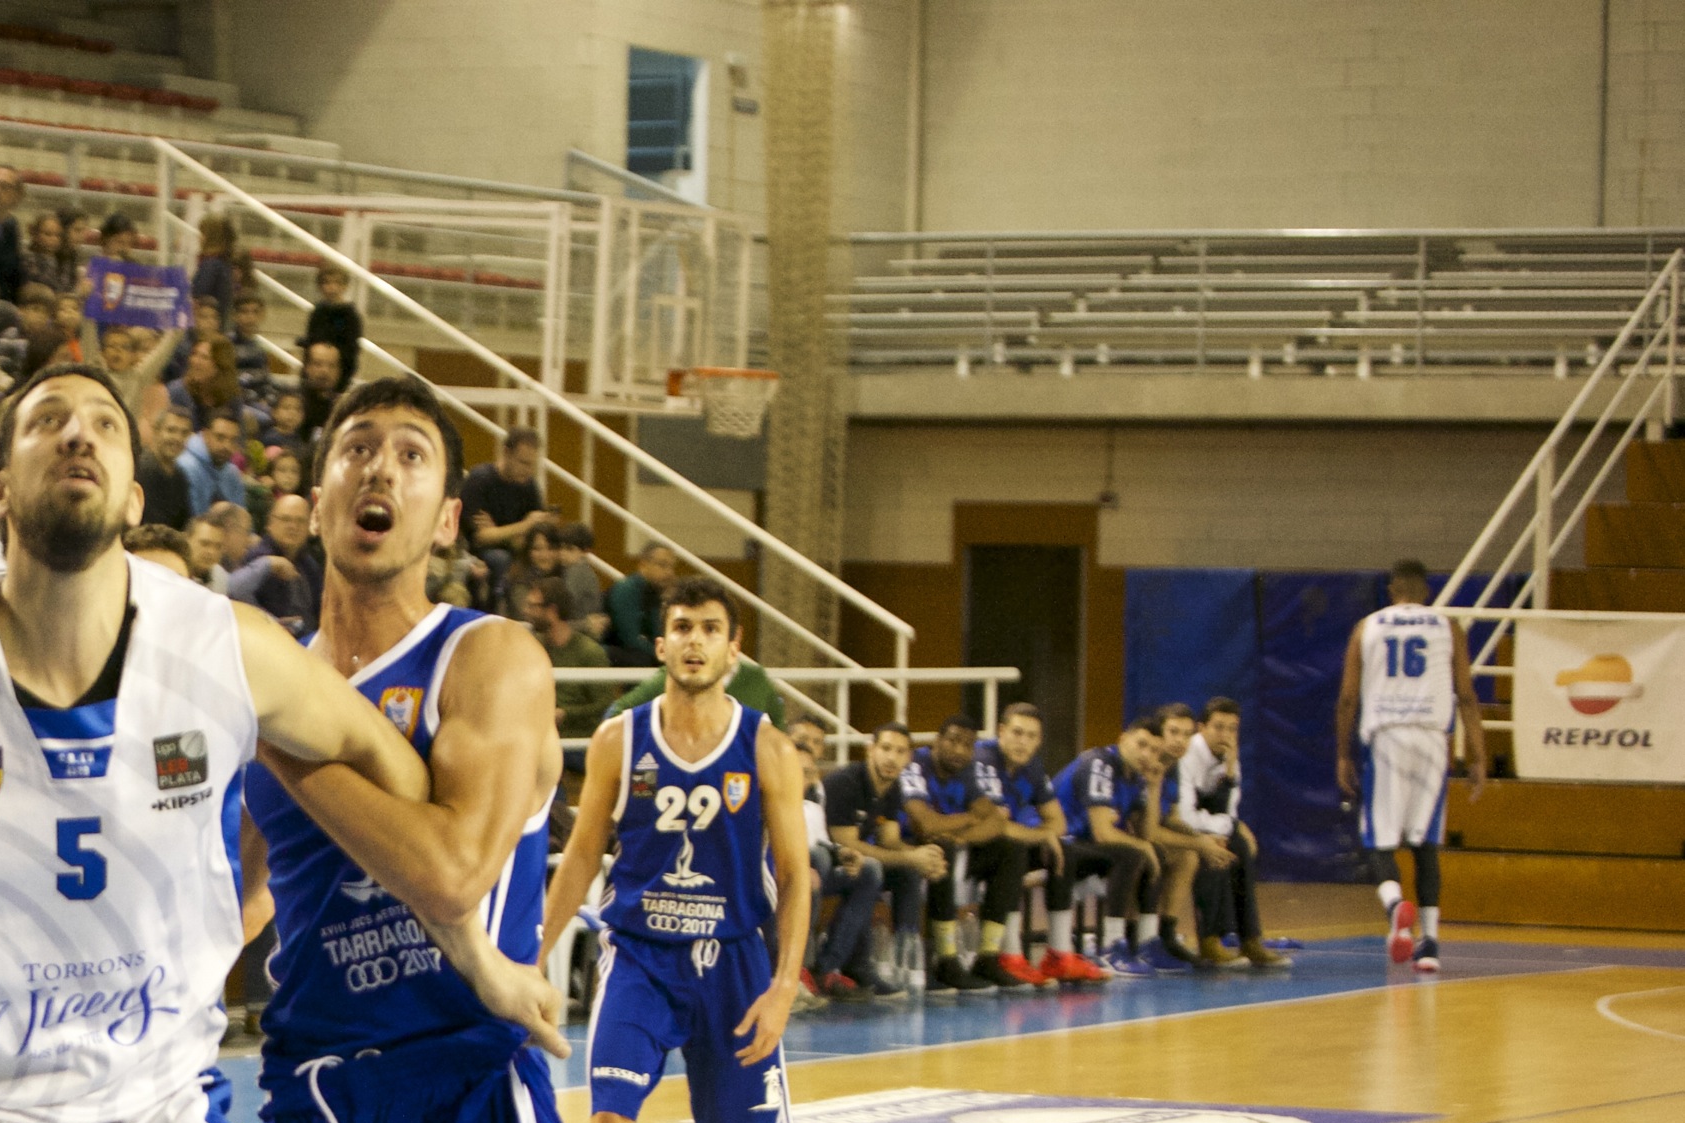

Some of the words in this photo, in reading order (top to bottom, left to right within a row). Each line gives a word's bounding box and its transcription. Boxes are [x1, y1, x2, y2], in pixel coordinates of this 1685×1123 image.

[1384, 635, 1428, 678] 16
[1543, 727, 1653, 747] REPSOL
[655, 785, 722, 832] 29
[56, 816, 107, 900] 5
[642, 898, 726, 920] TARRAGONA
[680, 918, 717, 936] 2017
[23, 951, 146, 983] TORRONS
[398, 946, 442, 976] 2017
